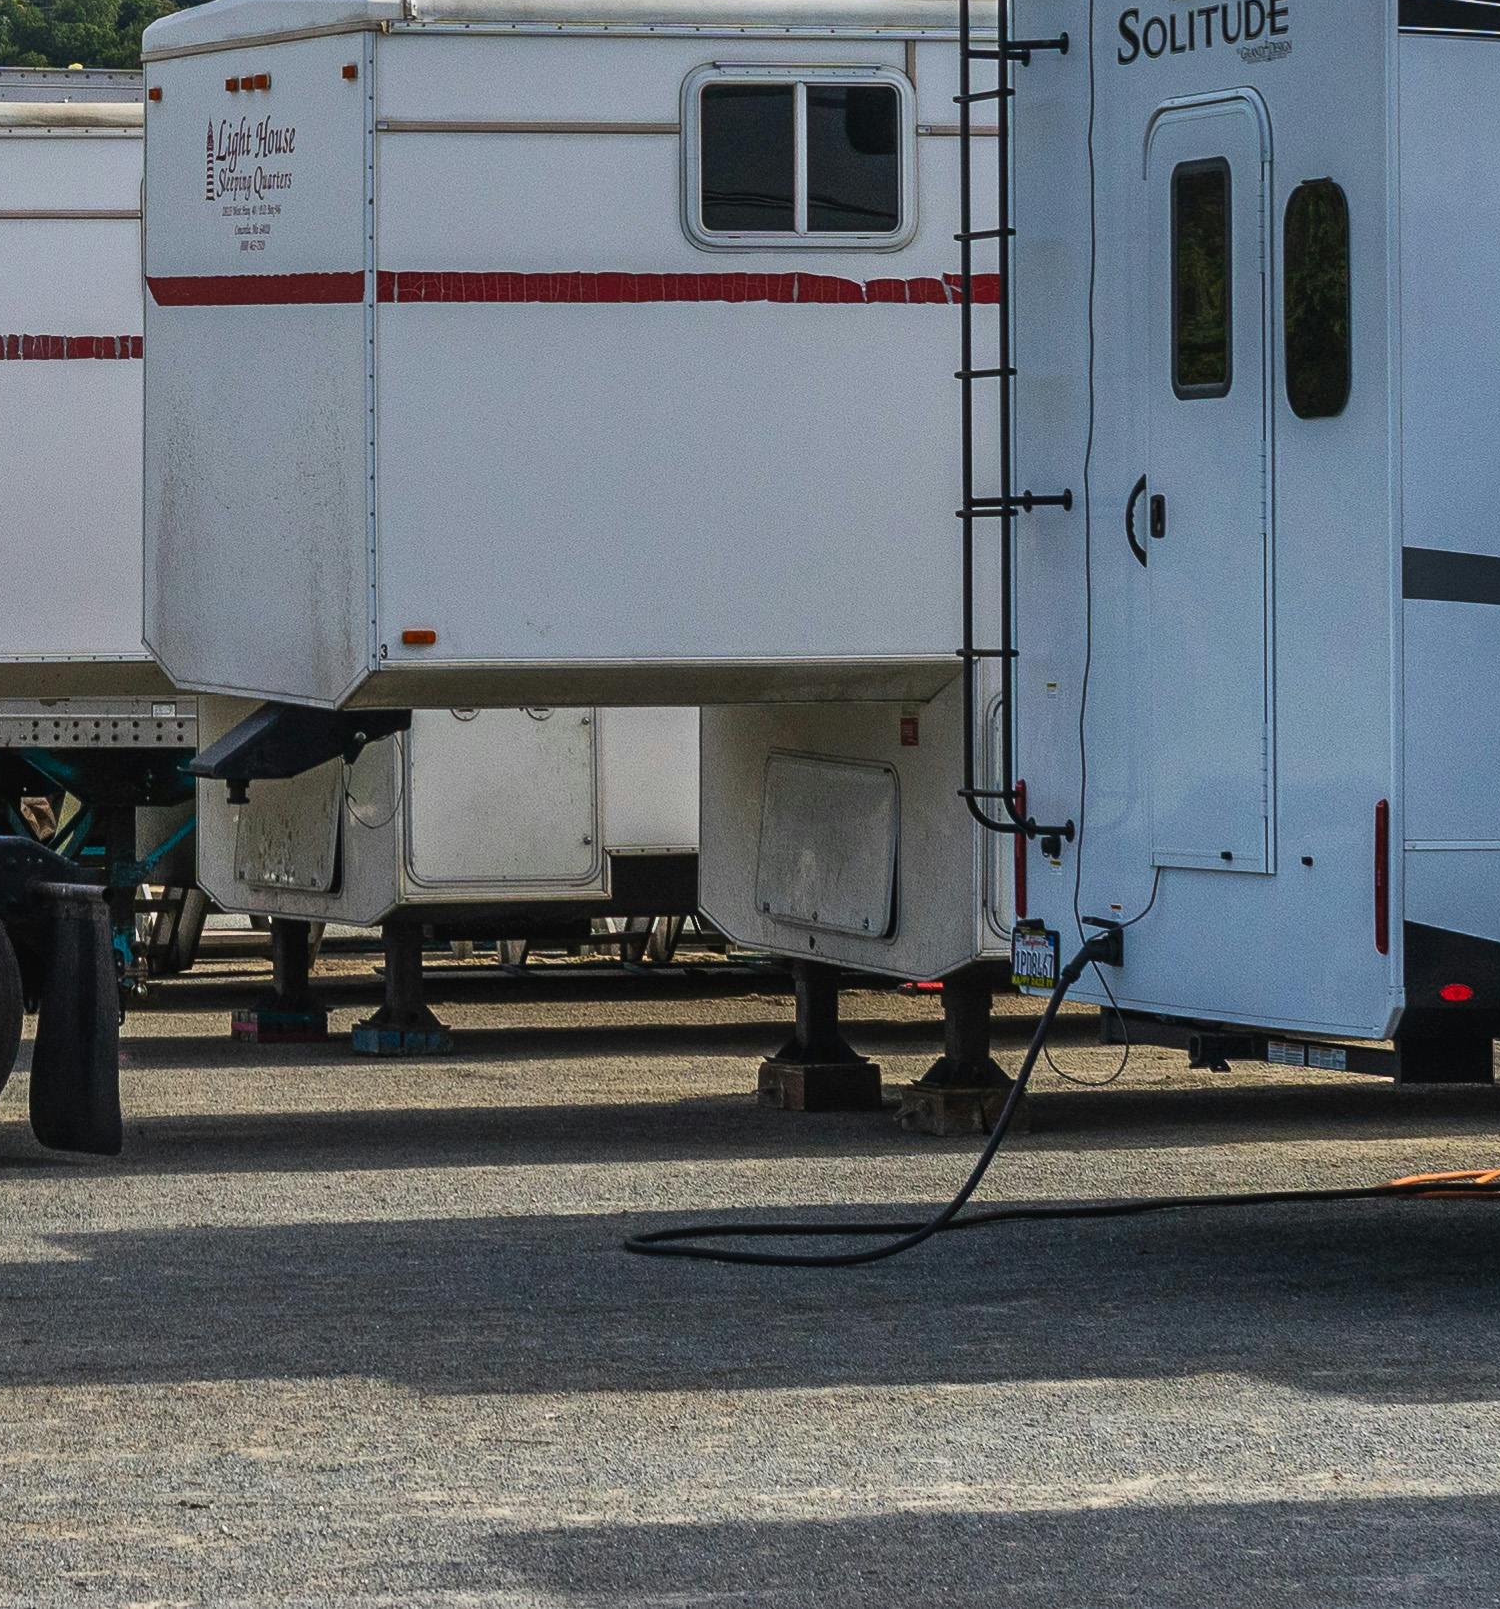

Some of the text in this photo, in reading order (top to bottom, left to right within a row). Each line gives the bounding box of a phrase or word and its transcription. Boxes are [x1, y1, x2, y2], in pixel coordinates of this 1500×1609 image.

[215, 114, 296, 173] Light House
[216, 165, 293, 202] Sleeping Quarters
[380, 643, 389, 660] 3
